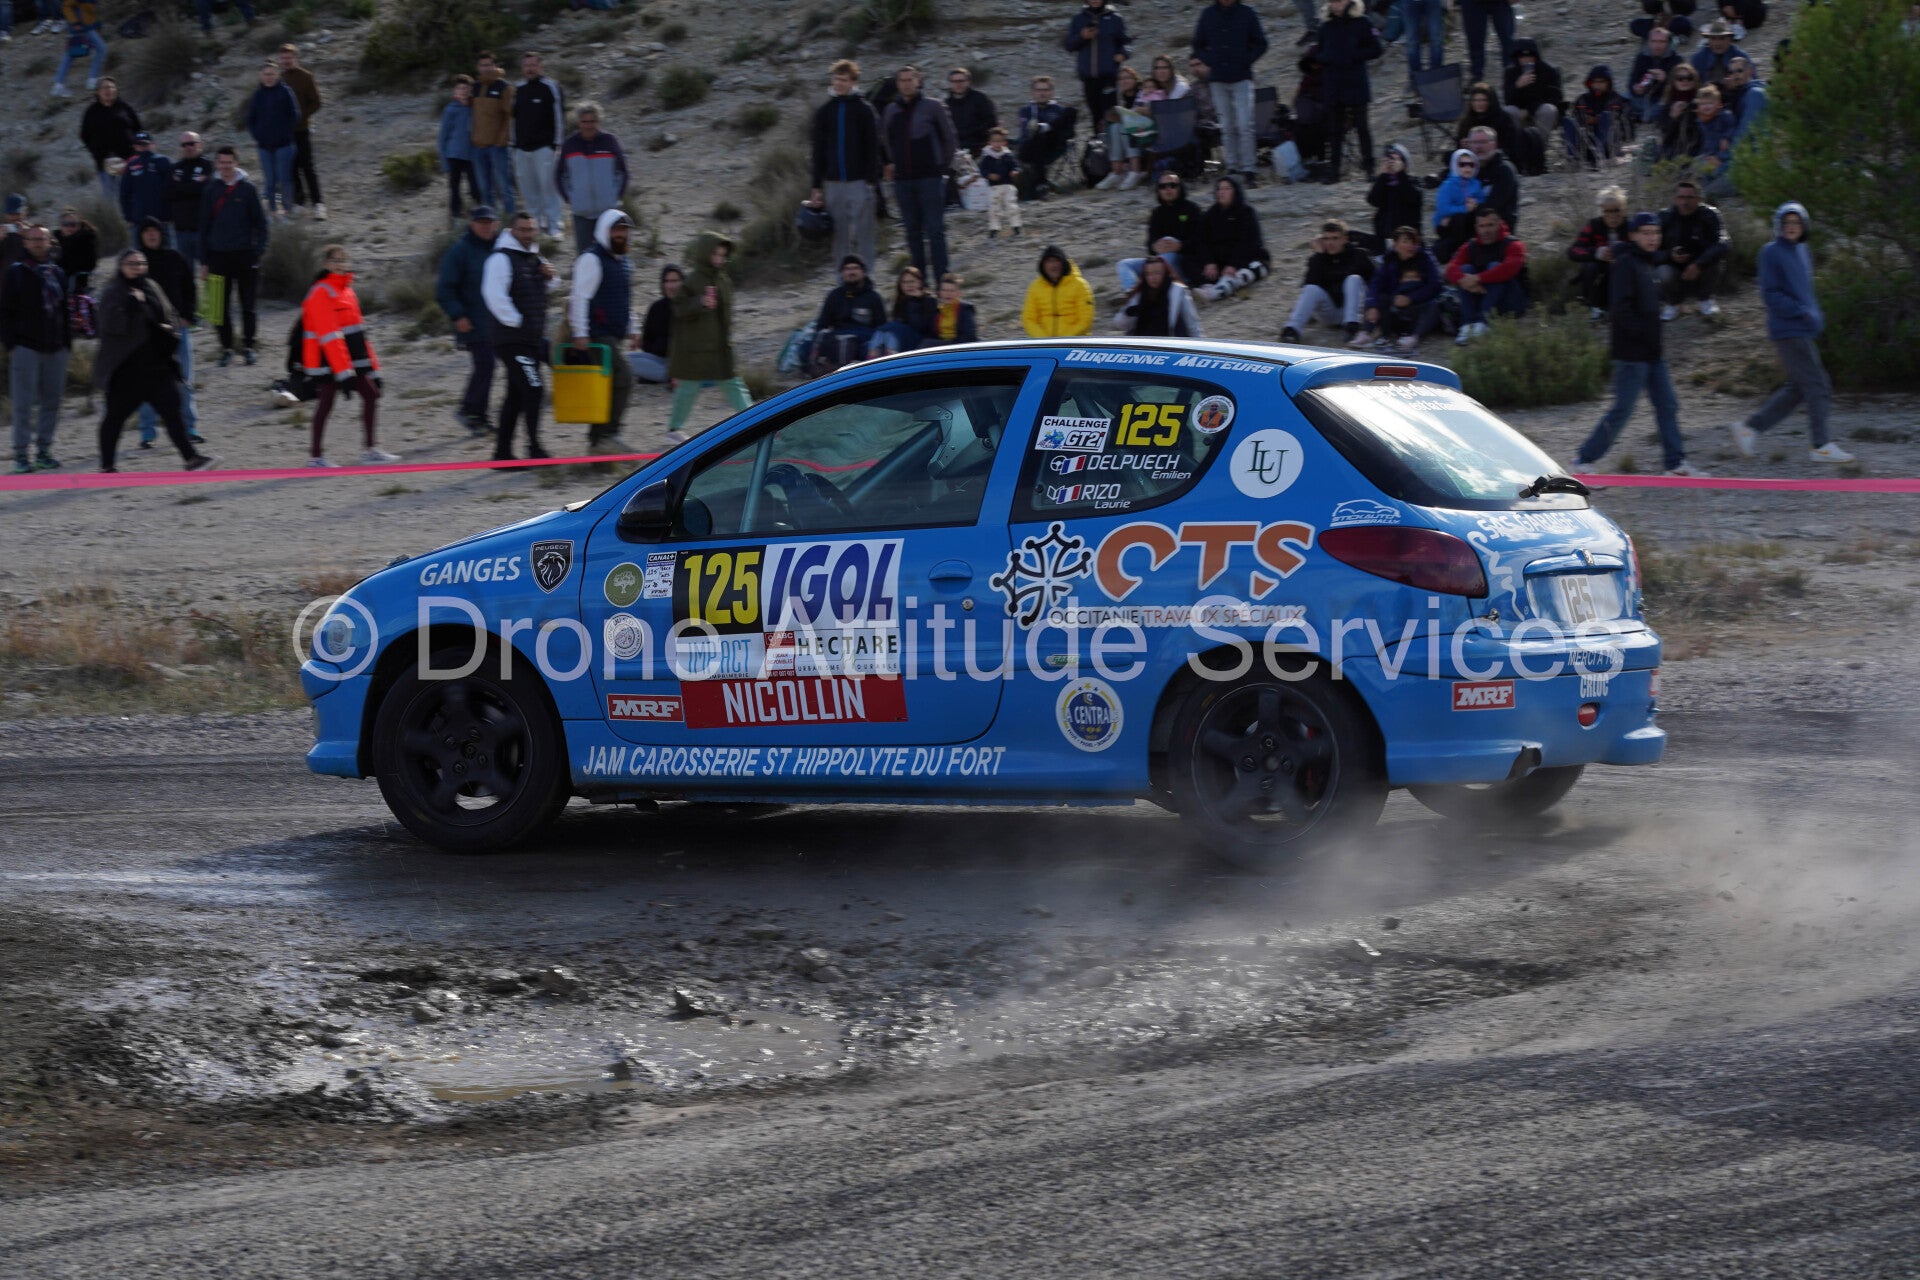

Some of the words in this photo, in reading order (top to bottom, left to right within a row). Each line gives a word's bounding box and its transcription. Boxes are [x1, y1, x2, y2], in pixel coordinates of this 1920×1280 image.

[1065, 350, 1170, 366] DUQUENNE
[1172, 355, 1275, 374] MOTEURS
[1044, 418, 1108, 429] CHALLENGE
[1115, 403, 1185, 447] 125
[1087, 454, 1180, 470] DELPUECH
[1151, 470, 1192, 479] Emilien
[1081, 483, 1121, 500] RIZO
[1094, 500, 1131, 509] Laurie
[648, 553, 675, 562] CANAL+
[419, 556, 522, 587] GANGES
[684, 551, 761, 626] 125
[767, 543, 897, 626] IGOL
[1561, 577, 1597, 624] 125
[1050, 609, 1139, 626] OCCITANIE
[1143, 609, 1218, 625] TRAVAUX
[798, 635, 898, 656] HECTARE
[688, 638, 751, 675] IMPACT
[1568, 650, 1595, 665] MERCI
[722, 678, 866, 723] NICOLLIN
[1456, 685, 1513, 706] MRF
[612, 699, 679, 718] MRF
[583, 746, 626, 775] JAM
[629, 747, 760, 776] CAROSSERIE
[763, 748, 792, 775] ST
[792, 747, 907, 776] HIPPOLYTE
[910, 748, 945, 776] DU
[945, 747, 1006, 776] FORT
